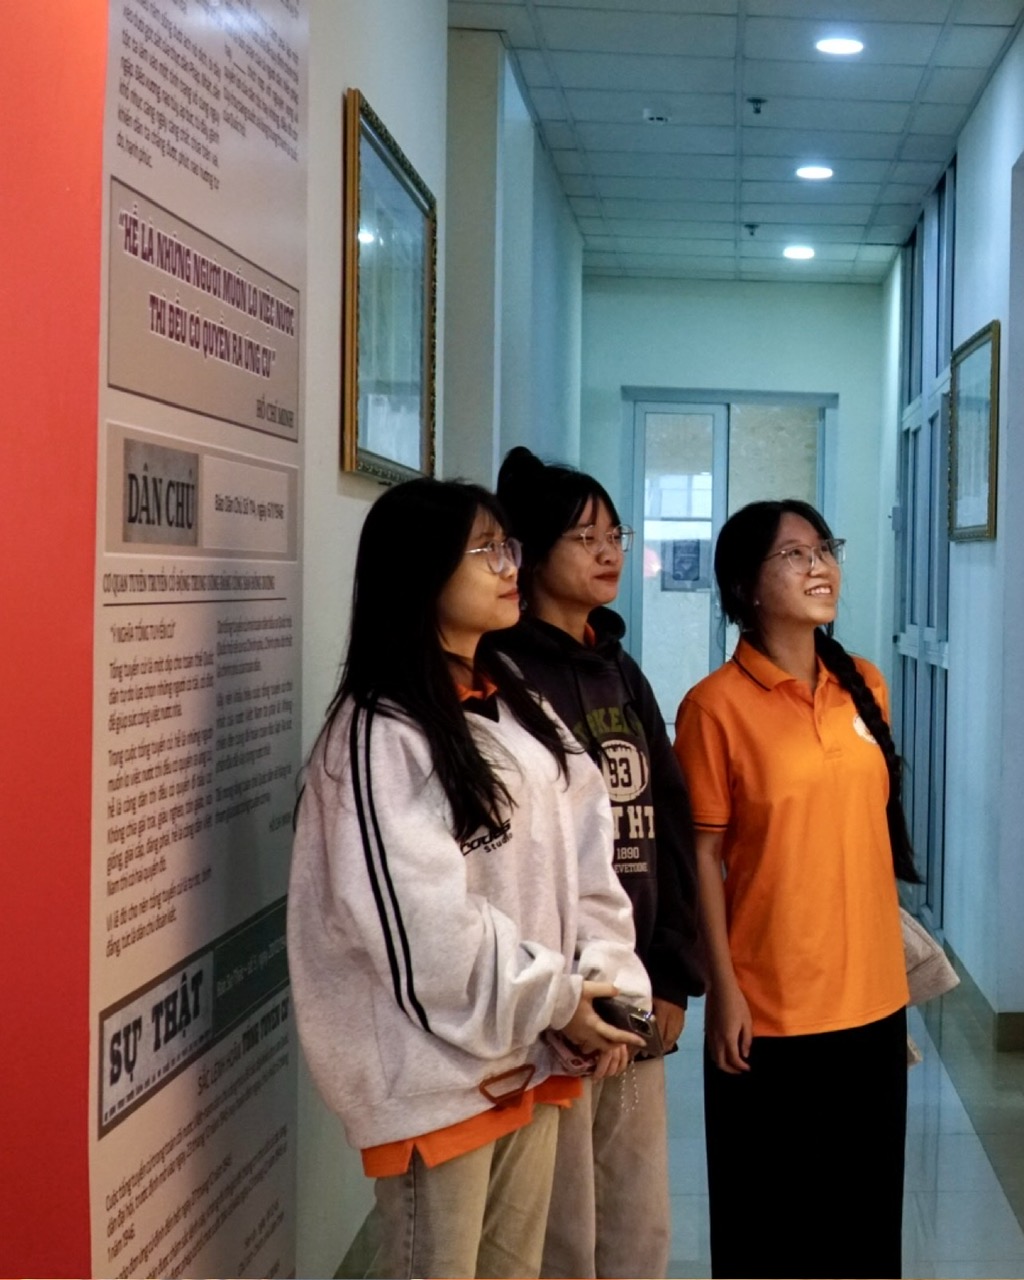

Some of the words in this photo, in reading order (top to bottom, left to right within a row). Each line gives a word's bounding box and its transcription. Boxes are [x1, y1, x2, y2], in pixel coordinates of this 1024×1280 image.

[127, 462, 163, 526] DÂN
[165, 468, 196, 530] CHỦ
[616, 846, 640, 860] 1890
[109, 1014, 142, 1085] SỰ
[151, 969, 204, 1054] THẬT
